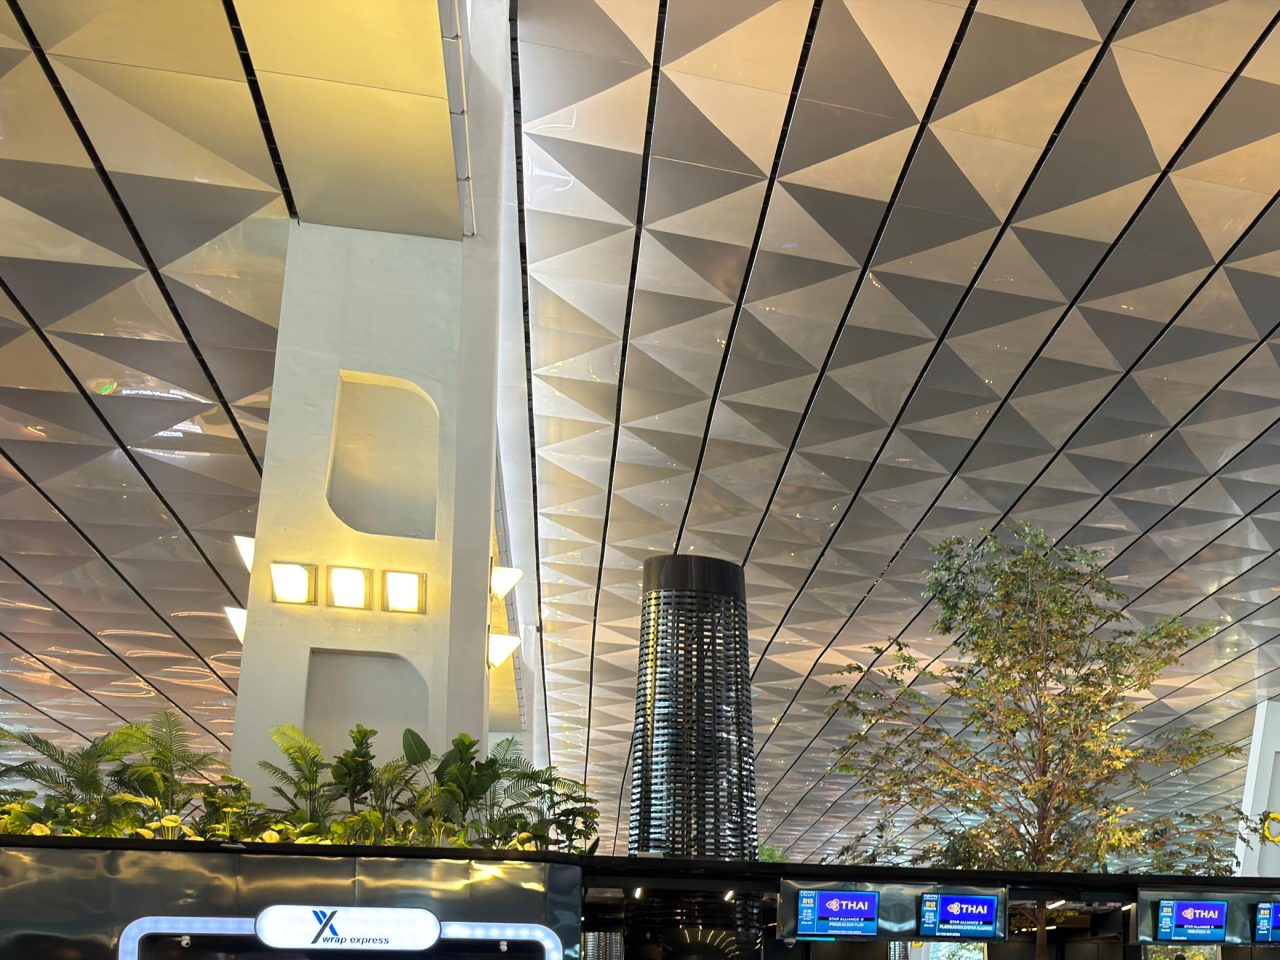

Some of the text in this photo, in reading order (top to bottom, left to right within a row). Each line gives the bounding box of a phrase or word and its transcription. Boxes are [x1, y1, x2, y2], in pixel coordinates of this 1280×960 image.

[840, 900, 868, 910] THAI
[961, 904, 988, 914] THAI
[1194, 909, 1218, 919] THAI
[322, 936, 390, 945] wrap express
